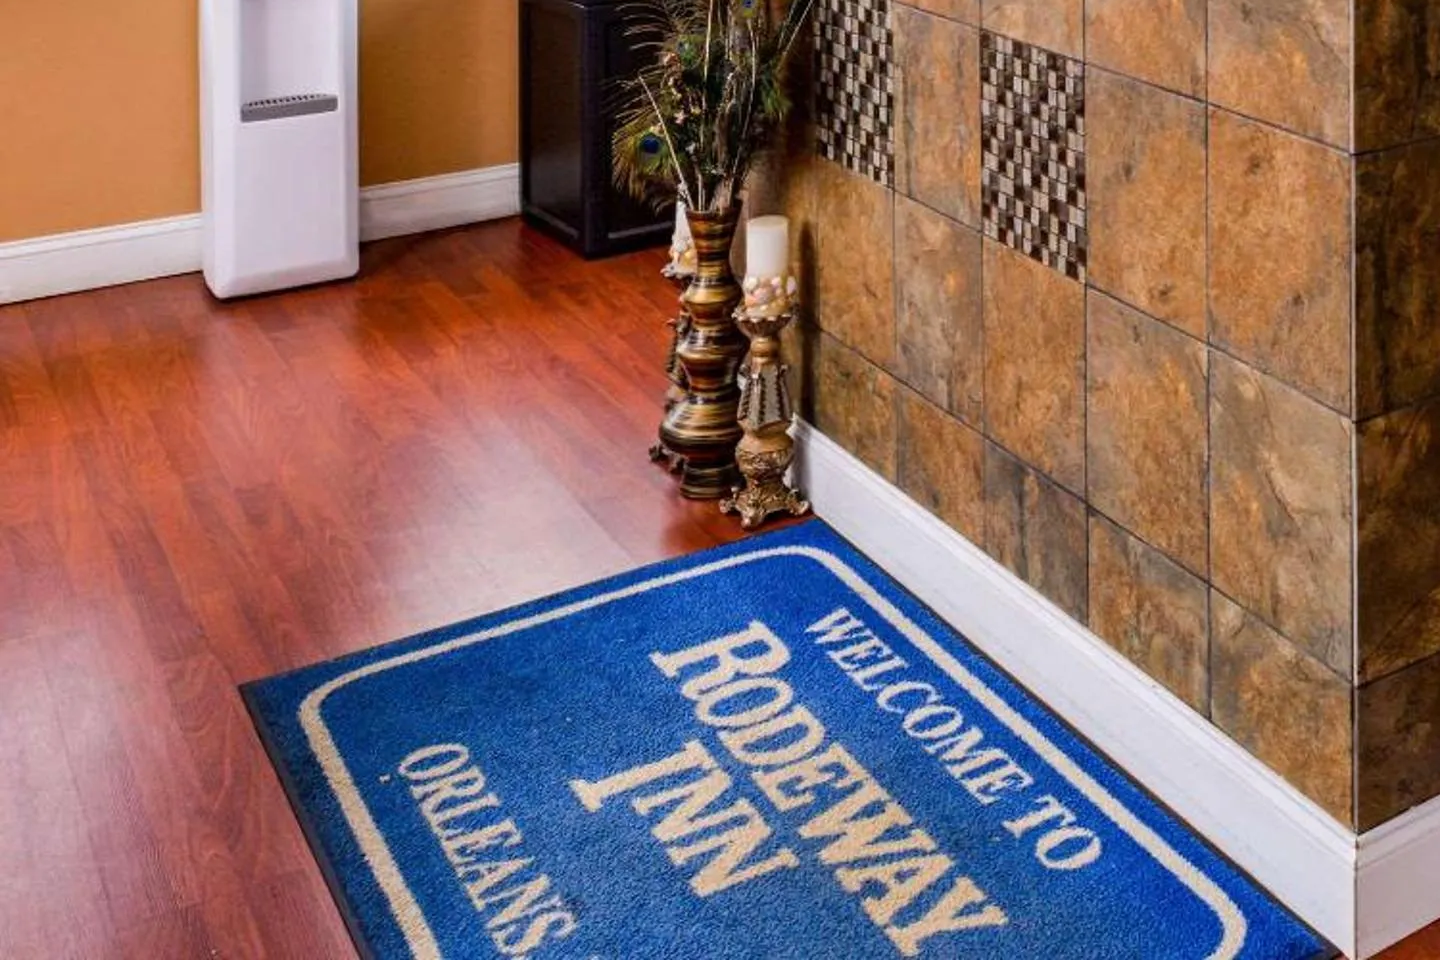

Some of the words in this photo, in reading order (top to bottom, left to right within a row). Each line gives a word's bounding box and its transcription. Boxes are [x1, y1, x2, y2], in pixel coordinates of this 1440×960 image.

[570, 740, 799, 897] INN
[648, 620, 1009, 958] RODEWAY
[805, 607, 1034, 806] WELCOME
[1004, 795, 1102, 870] TO
